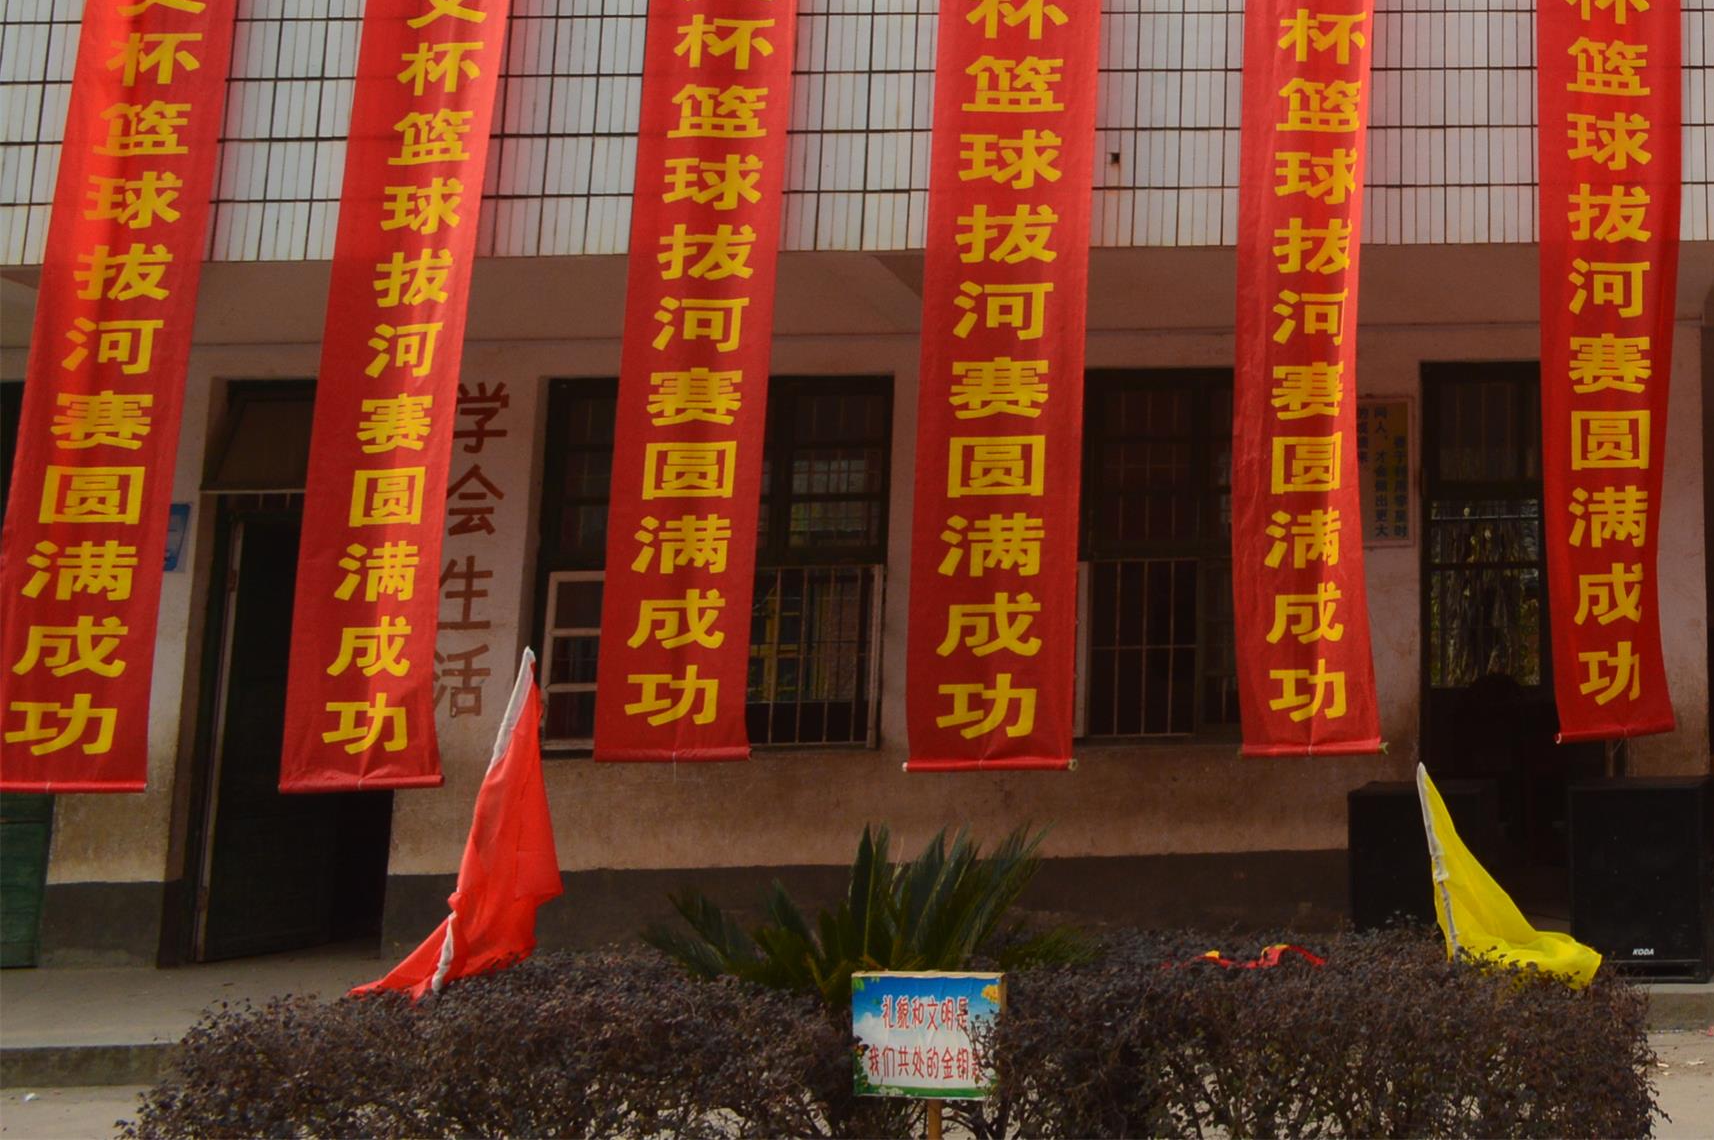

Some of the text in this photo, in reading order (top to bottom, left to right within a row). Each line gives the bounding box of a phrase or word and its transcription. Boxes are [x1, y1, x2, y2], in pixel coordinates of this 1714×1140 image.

[434, 381, 510, 720] 学会生活
[882, 996, 968, 1031] 礼貌和文明是
